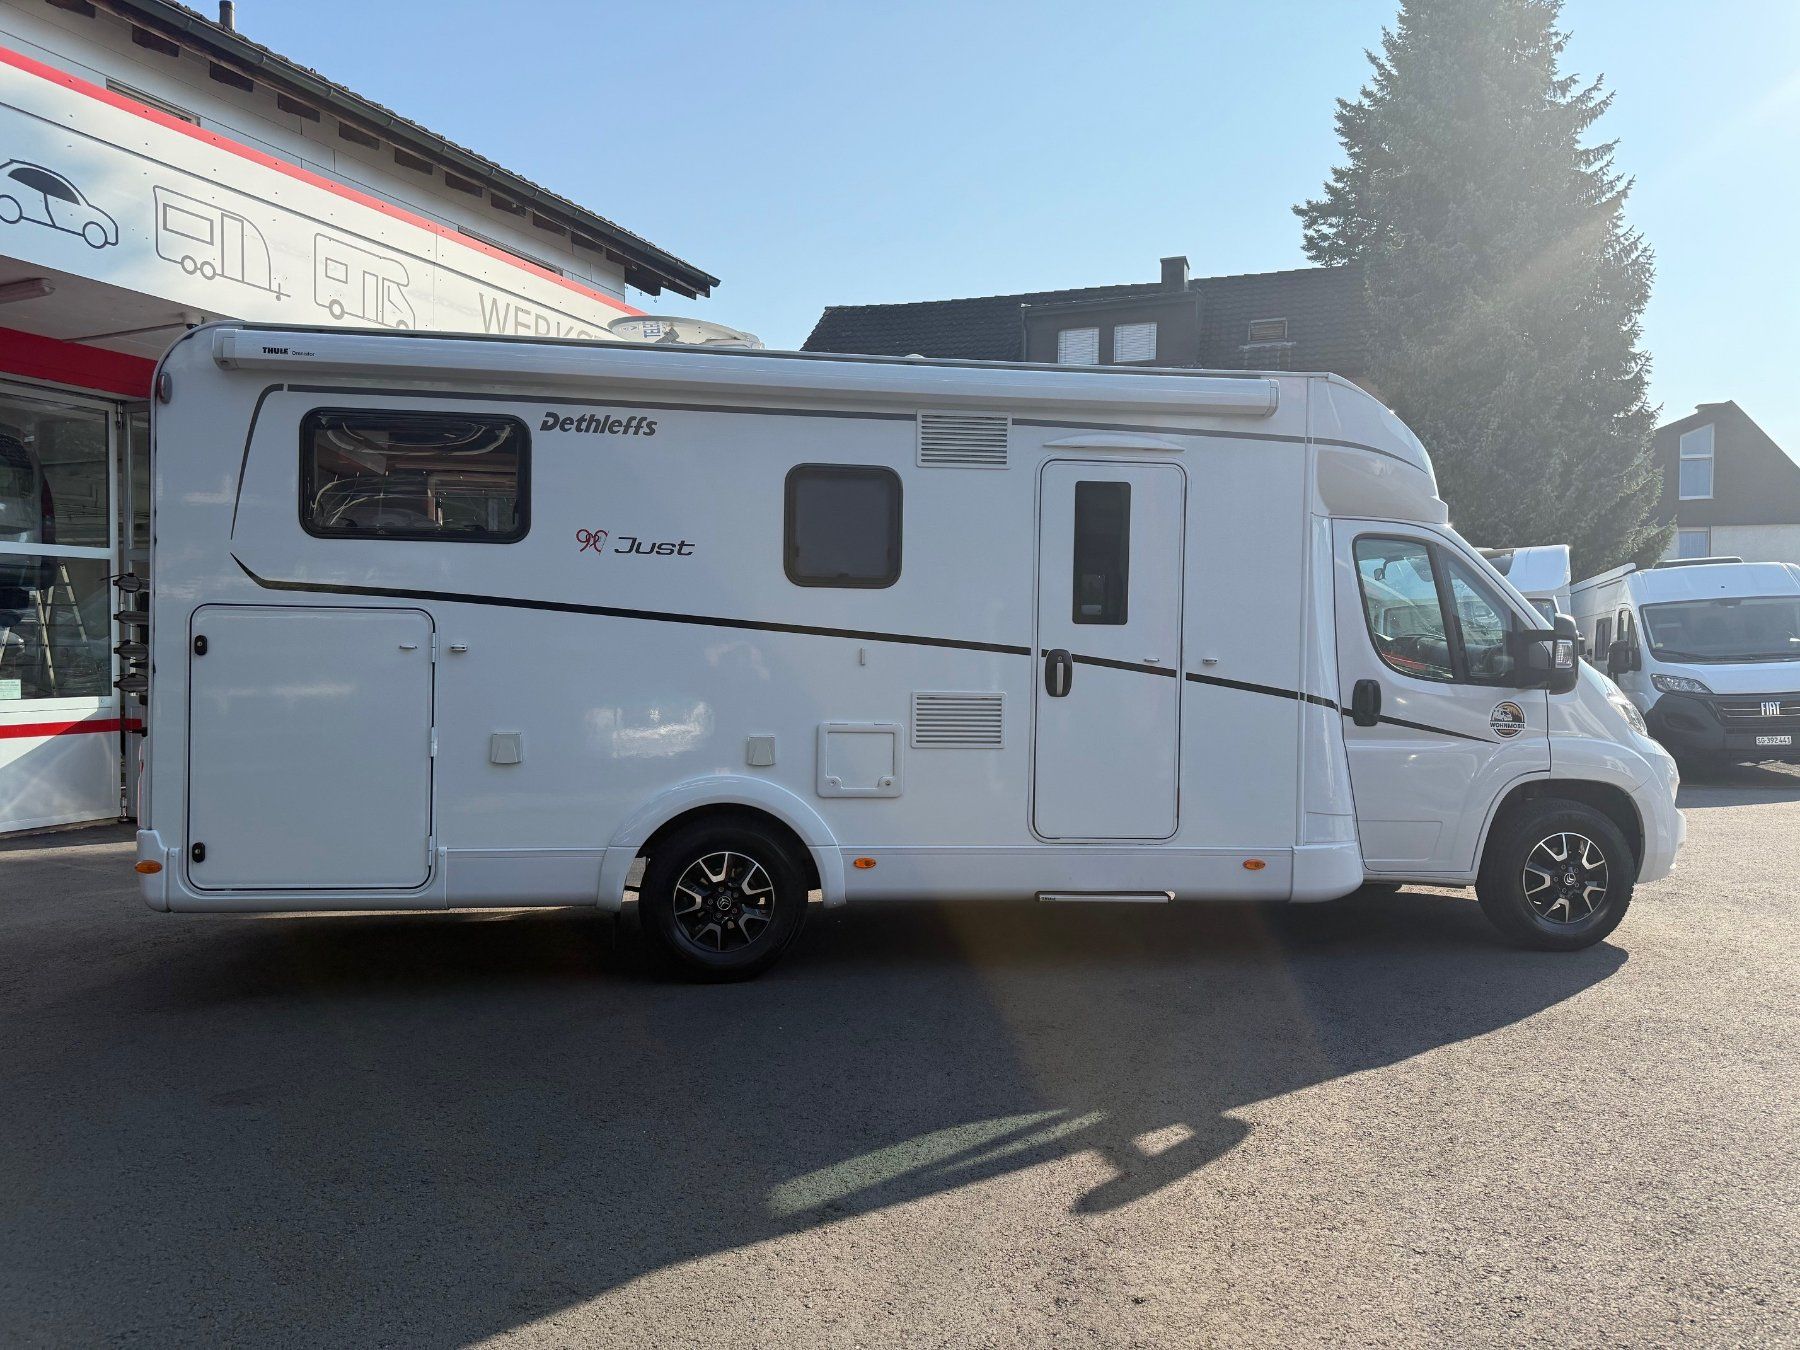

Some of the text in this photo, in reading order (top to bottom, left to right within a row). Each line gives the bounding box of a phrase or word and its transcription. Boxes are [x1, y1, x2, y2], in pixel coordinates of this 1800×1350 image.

[479, 292, 602, 338] WER
[262, 346, 289, 355] THULE
[540, 411, 658, 437] Dethleffs
[614, 536, 696, 556] Just
[1760, 701, 1781, 716] FIAT
